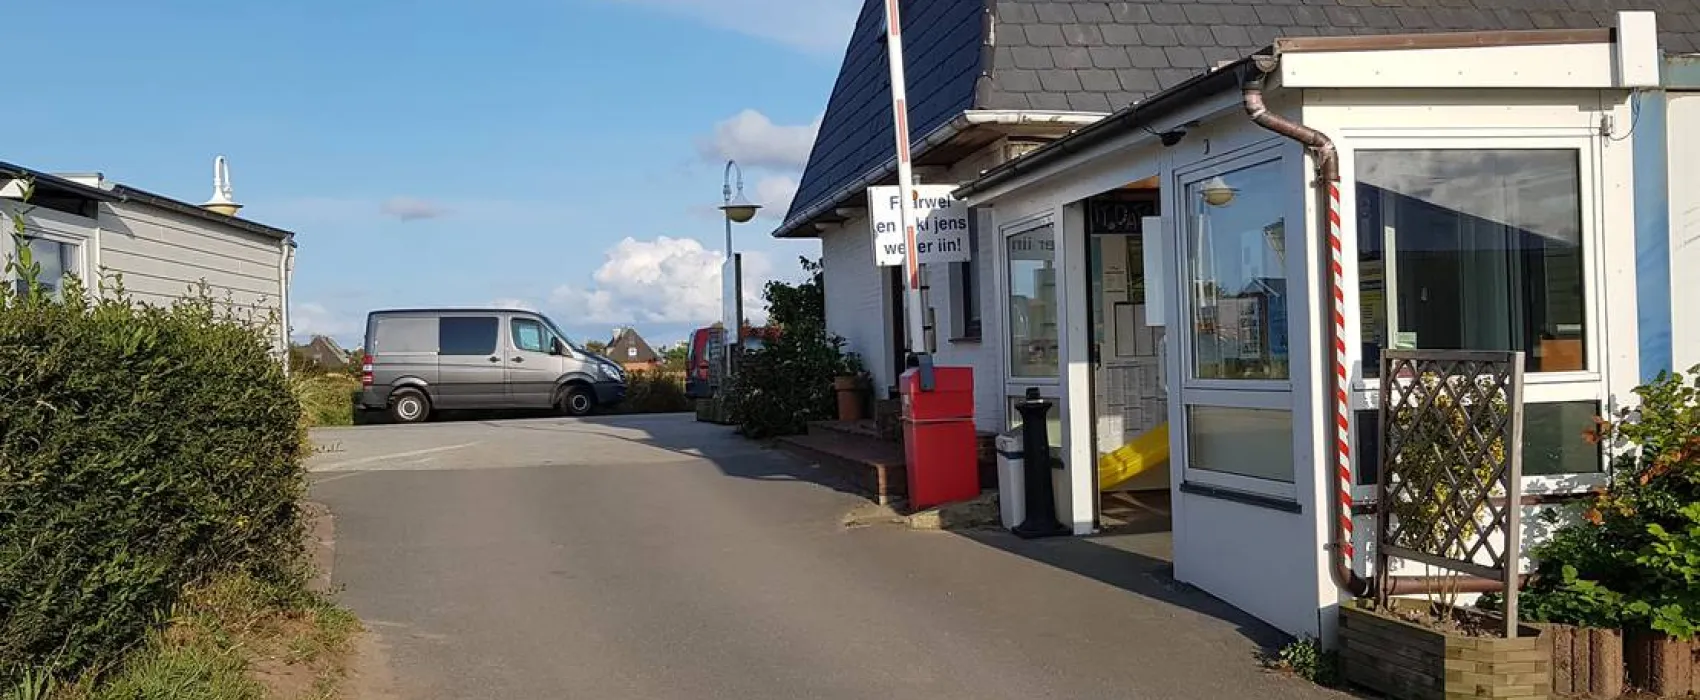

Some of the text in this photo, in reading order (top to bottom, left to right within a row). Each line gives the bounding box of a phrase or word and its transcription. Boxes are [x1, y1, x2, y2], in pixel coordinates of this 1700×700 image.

[876, 221, 896, 233] en
[934, 217, 967, 234] jens
[884, 236, 961, 255] weer iin!
